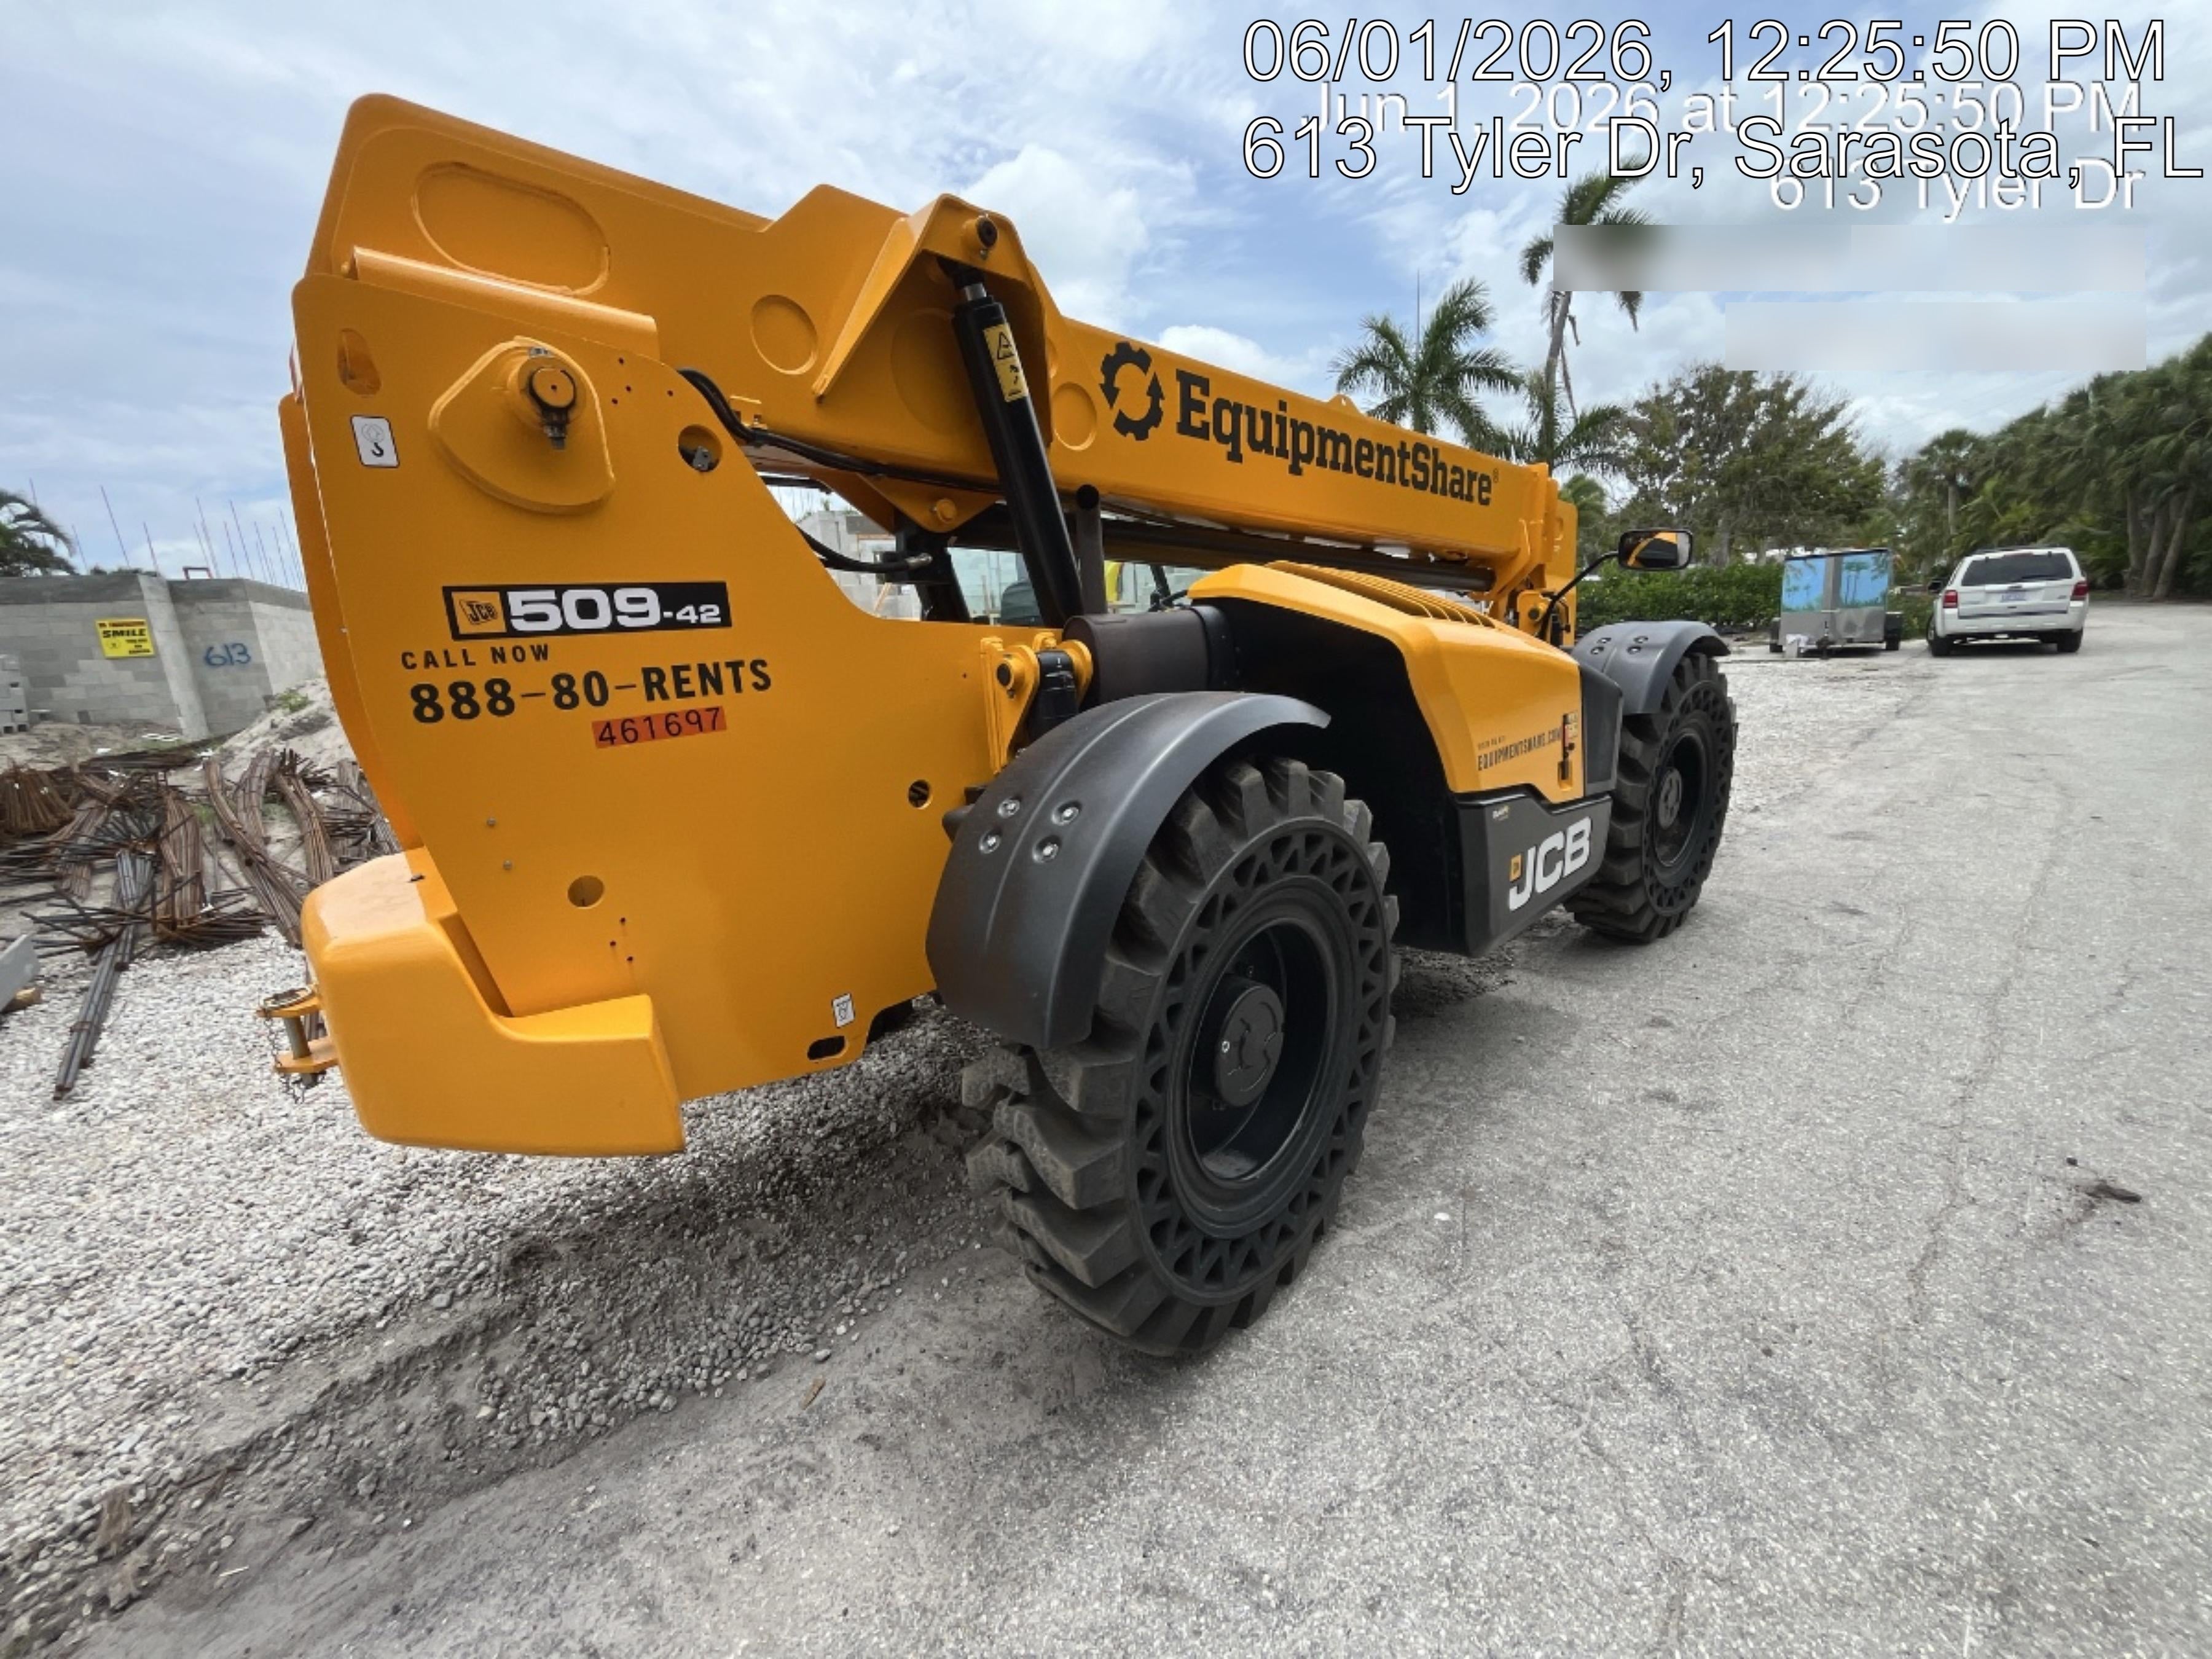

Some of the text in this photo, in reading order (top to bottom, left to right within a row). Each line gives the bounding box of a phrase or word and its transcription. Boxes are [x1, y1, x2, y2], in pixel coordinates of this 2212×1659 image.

[1175, 369, 1493, 506] EquipmentShare
[506, 587, 721, 632] 509-42
[103, 628, 147, 638] SMILE
[205, 643, 251, 667] 613
[401, 643, 549, 670] CALL NOW
[410, 659, 772, 724] 888-80-RENTS
[597, 707, 723, 745] 461697
[1508, 816, 1592, 912] JCB
